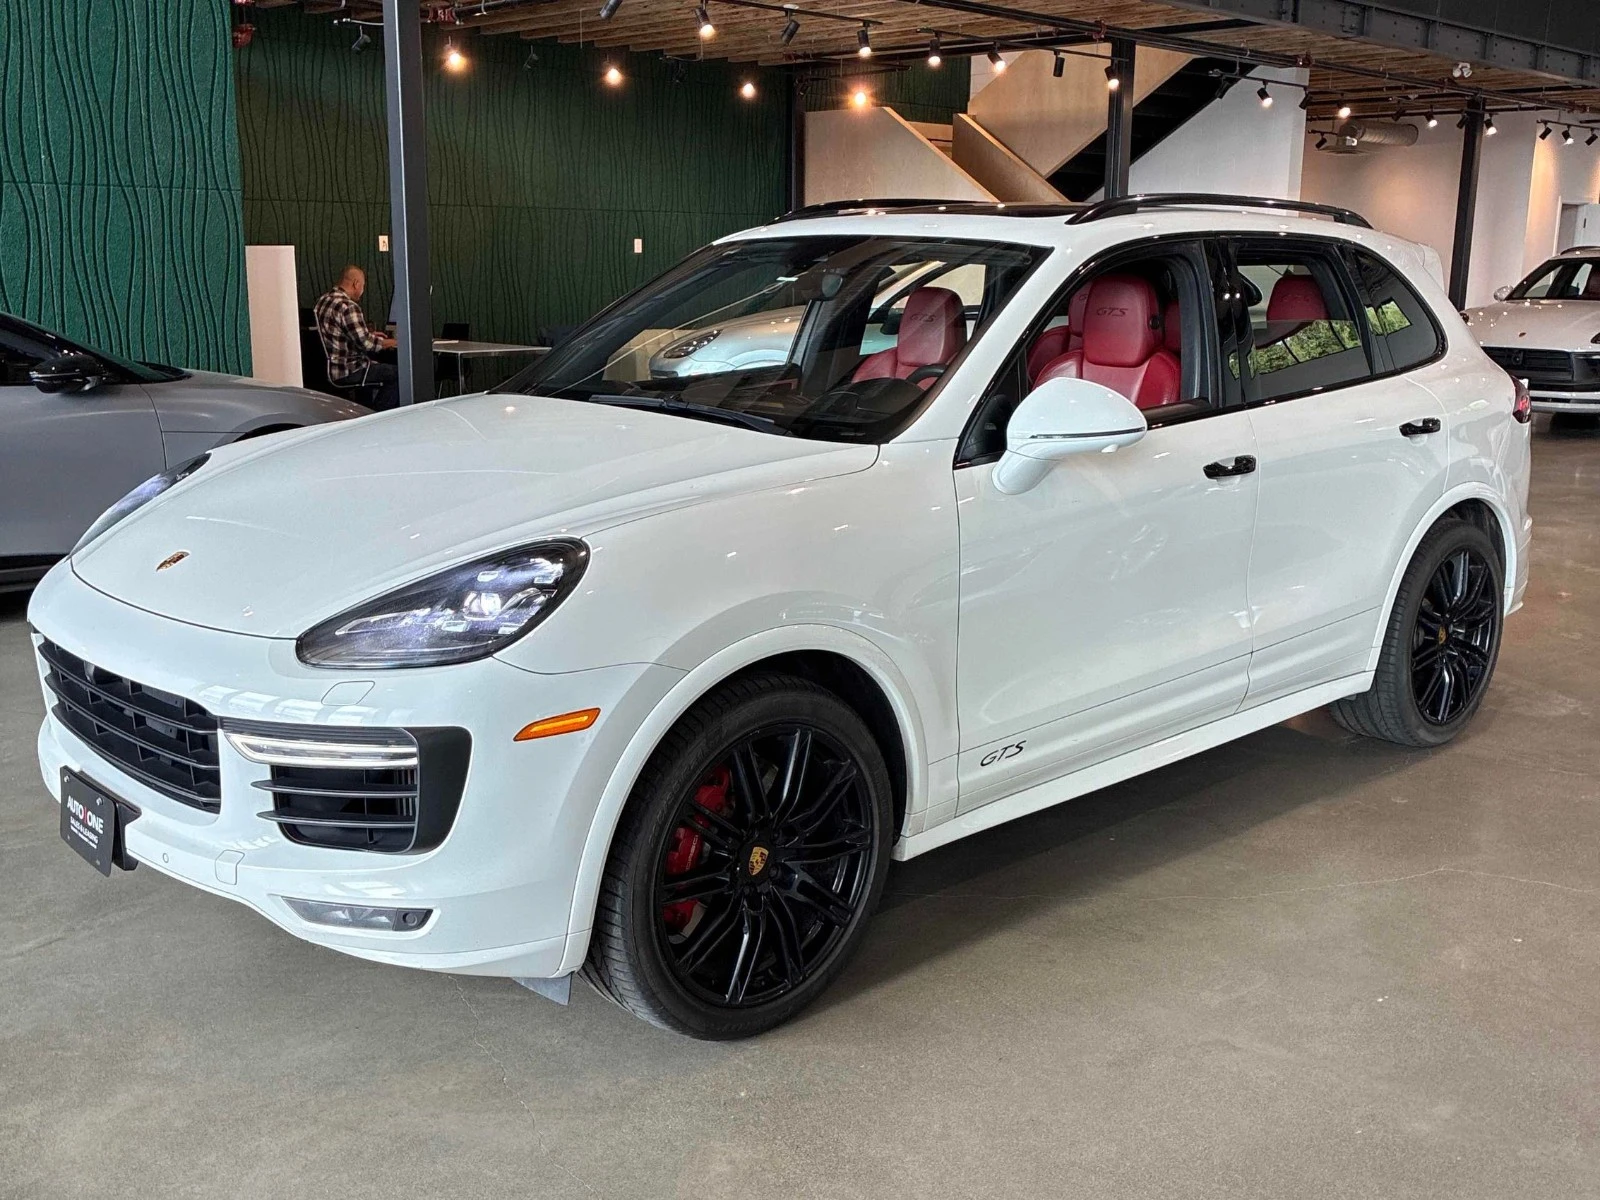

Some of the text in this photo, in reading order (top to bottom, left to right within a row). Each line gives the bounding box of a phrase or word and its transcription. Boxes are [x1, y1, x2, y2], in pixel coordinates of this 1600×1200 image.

[911, 312, 937, 323] GTS
[1096, 306, 1129, 317] GTS
[980, 739, 1027, 767] GTS
[67, 795, 103, 834] AUTO ONE
